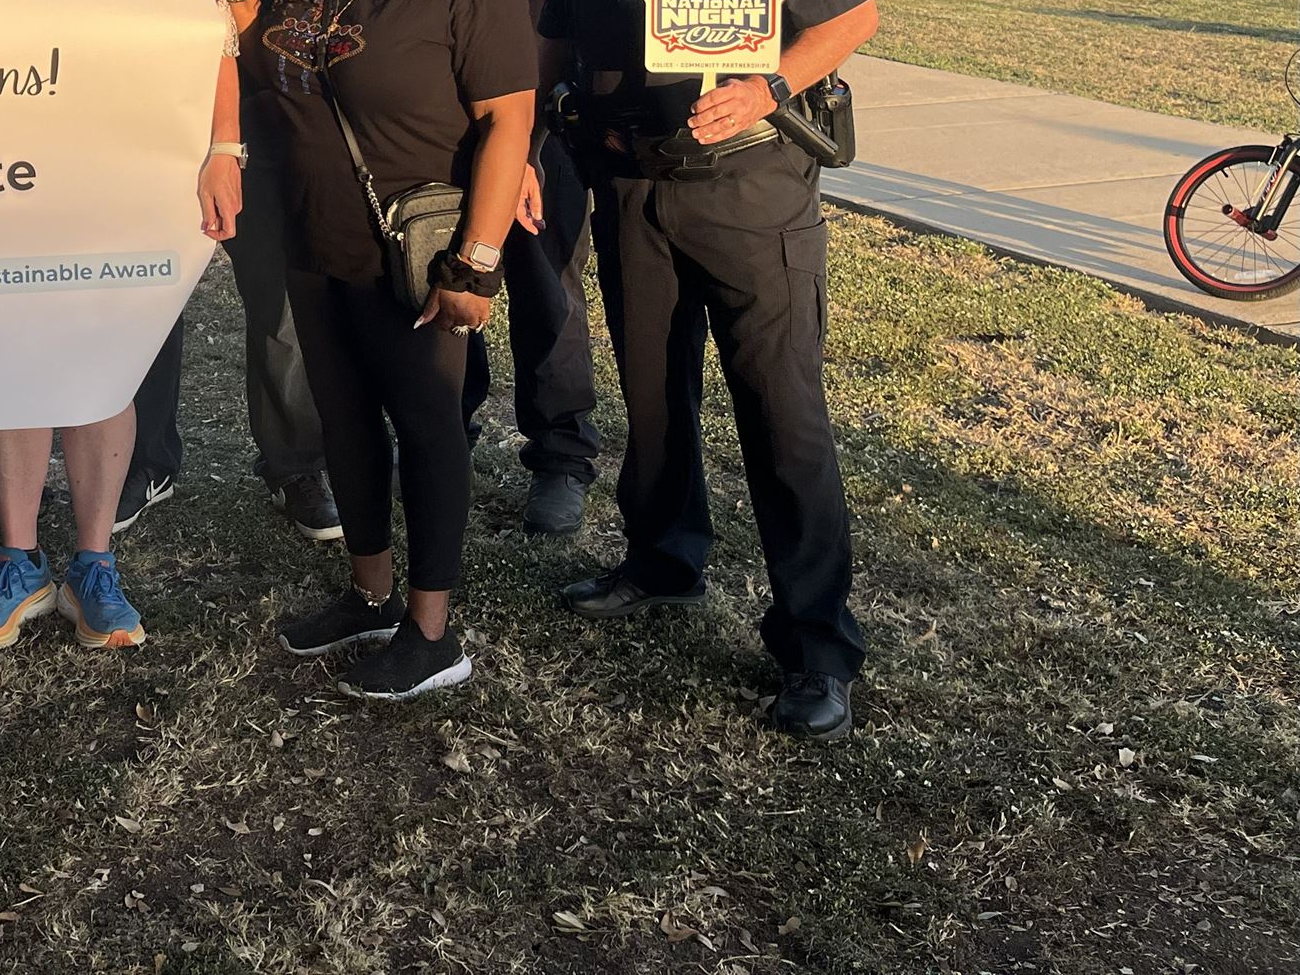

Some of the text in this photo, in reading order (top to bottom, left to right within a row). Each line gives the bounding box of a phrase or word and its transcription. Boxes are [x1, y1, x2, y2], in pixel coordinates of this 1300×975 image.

[661, 8, 766, 29] NIGHT
[685, 25, 739, 44] Out
[100, 259, 172, 280] Award
